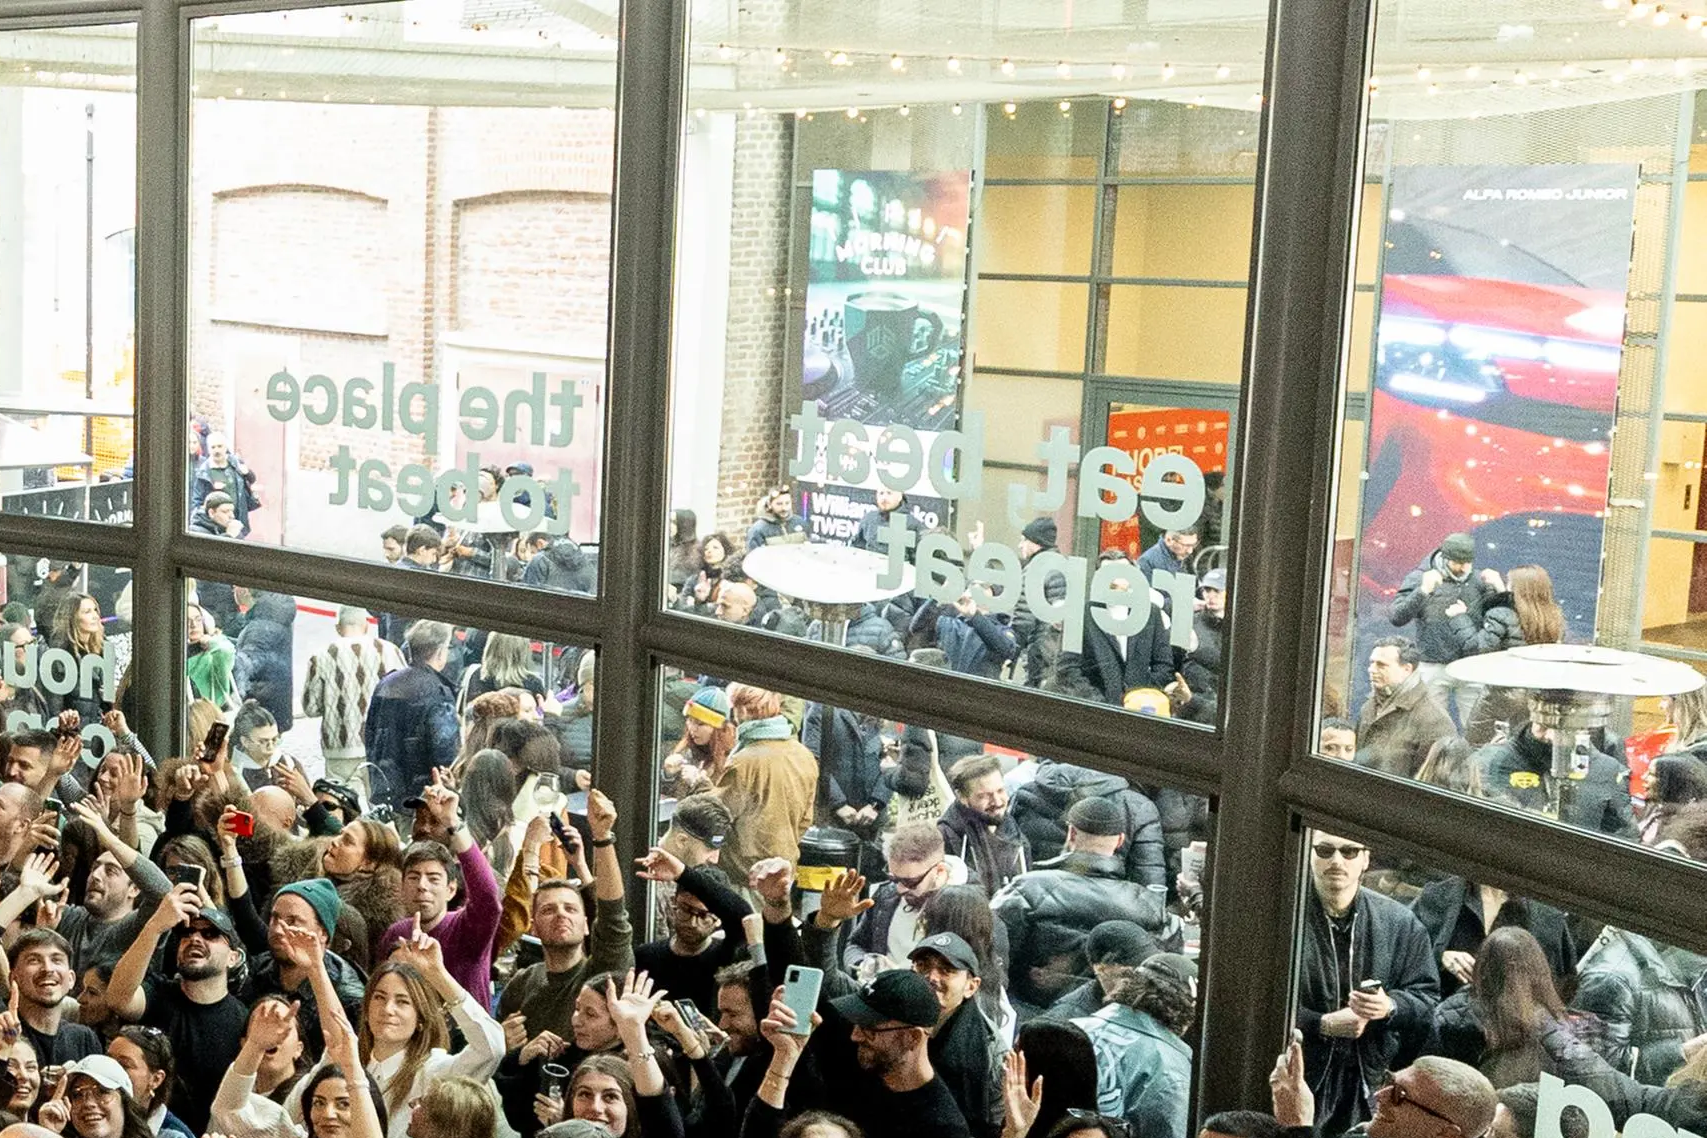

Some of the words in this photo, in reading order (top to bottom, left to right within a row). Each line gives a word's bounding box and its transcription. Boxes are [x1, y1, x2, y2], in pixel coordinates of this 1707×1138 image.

[1463, 188, 1503, 201] ALFA
[1506, 188, 1563, 201] ROMEO
[1565, 188, 1629, 201] JUNIOR
[835, 231, 936, 264] MORNING
[860, 256, 907, 276] CLUB
